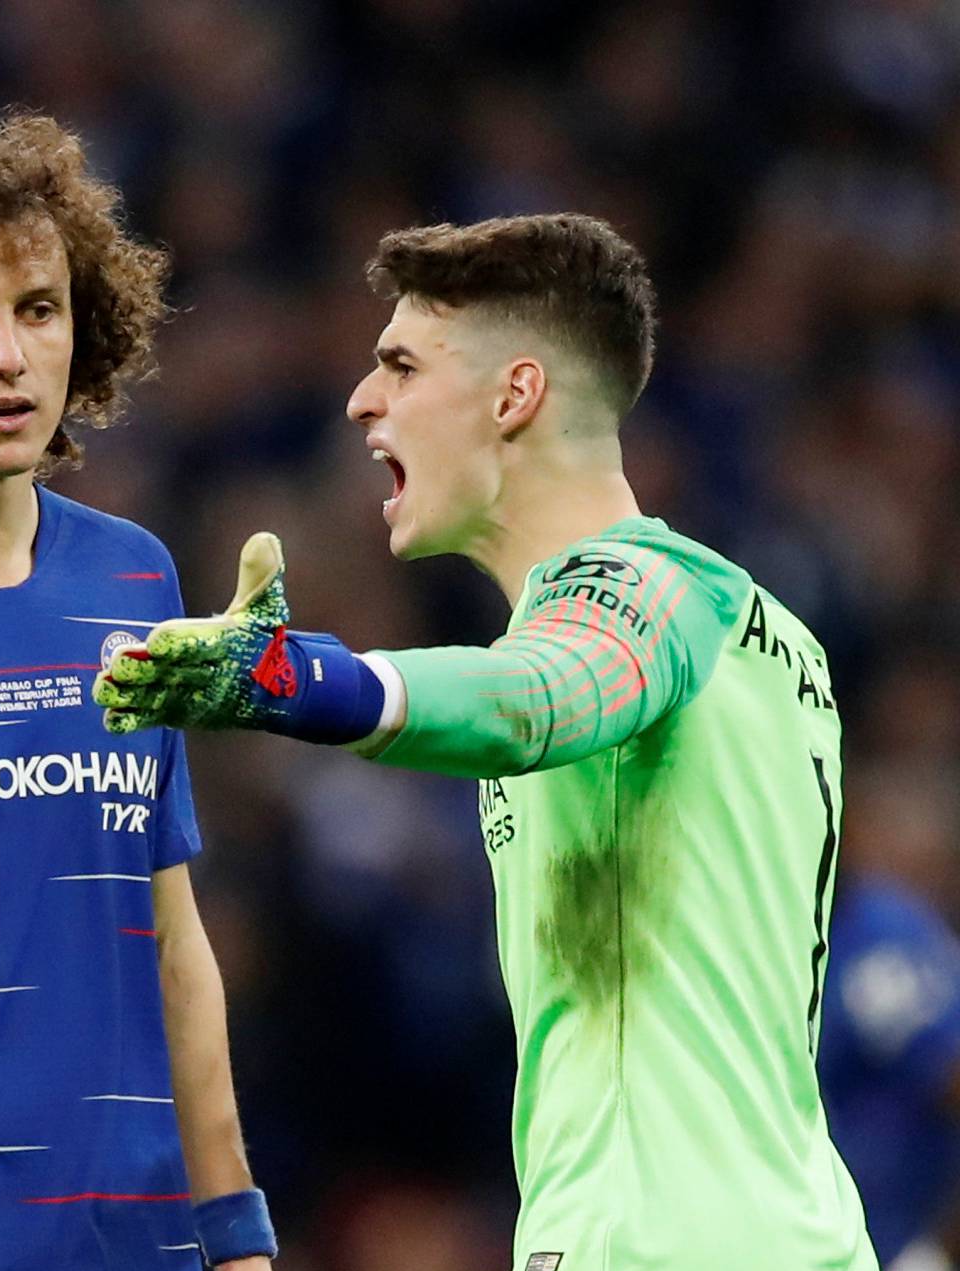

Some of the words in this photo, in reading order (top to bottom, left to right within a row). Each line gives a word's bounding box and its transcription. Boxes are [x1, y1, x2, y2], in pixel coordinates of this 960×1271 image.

[34, 678, 53, 689] CUP
[55, 676, 82, 687] FINAL
[14, 689, 58, 701] FEBRUARY
[41, 696, 82, 709] STADIUM
[101, 802, 150, 833] TYR
